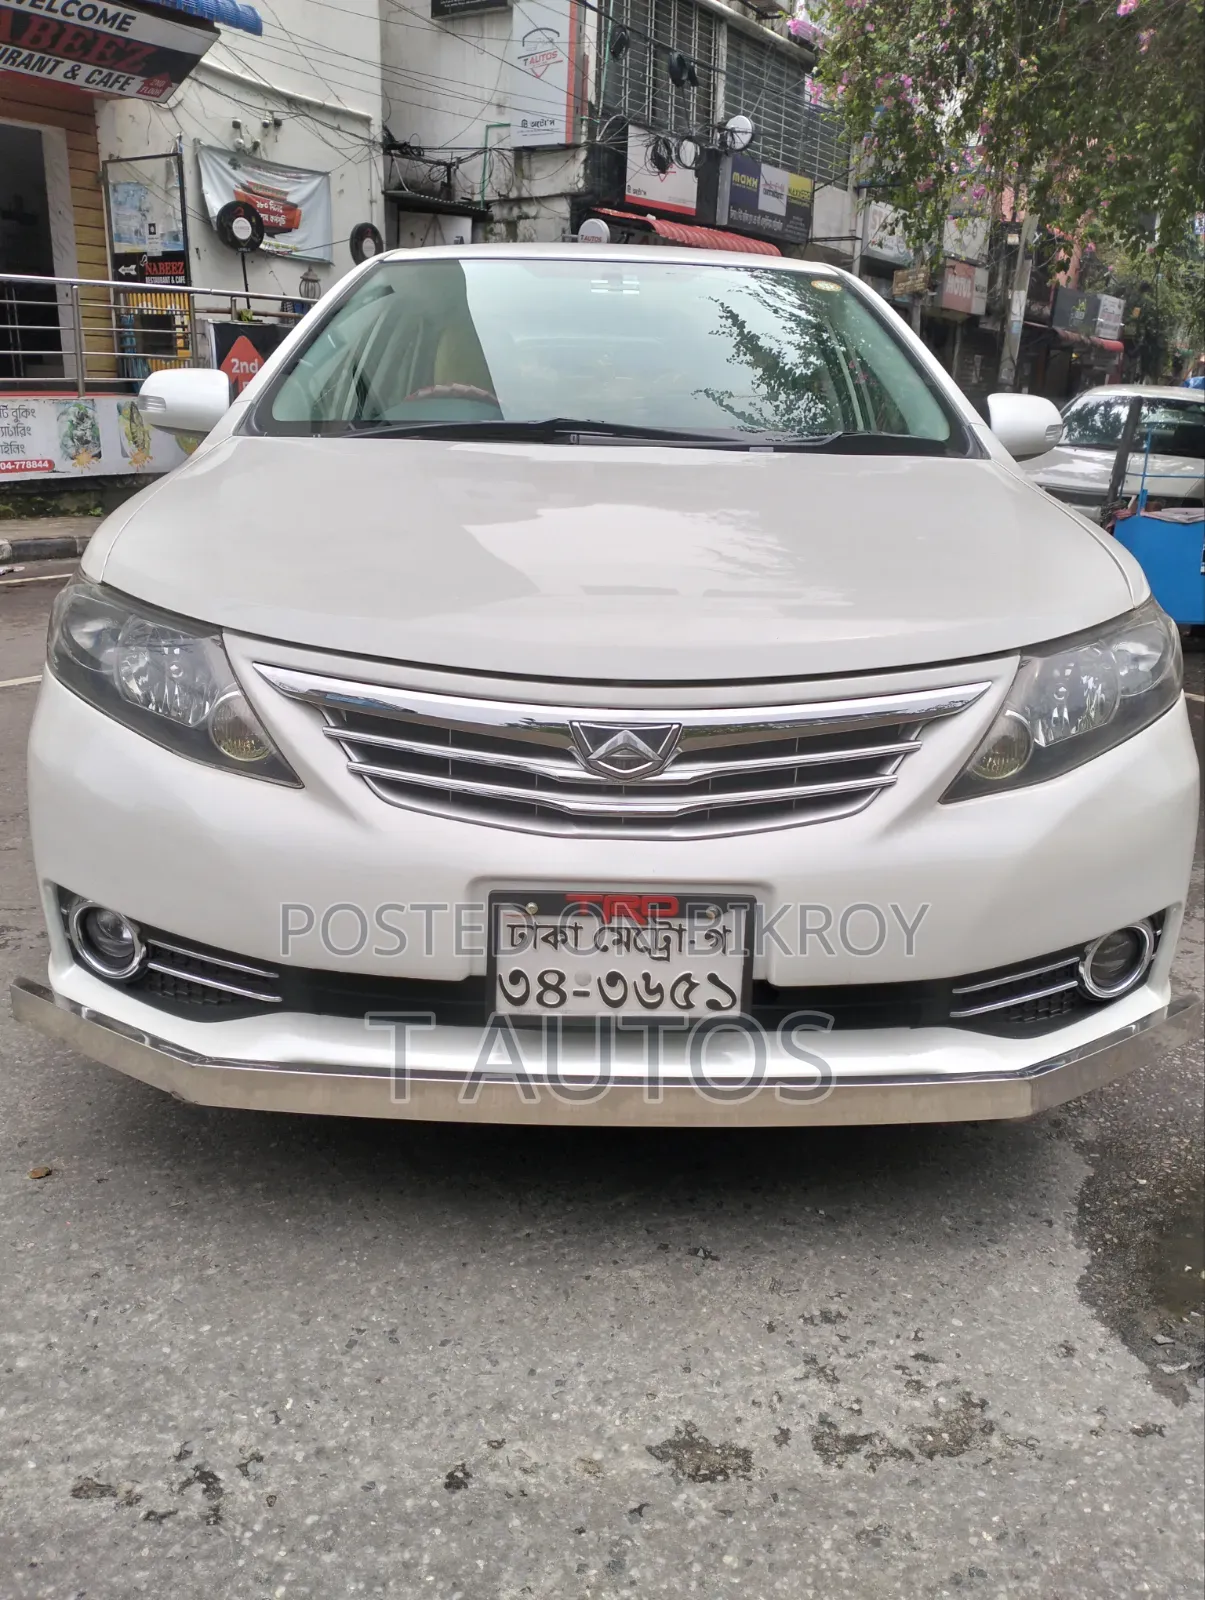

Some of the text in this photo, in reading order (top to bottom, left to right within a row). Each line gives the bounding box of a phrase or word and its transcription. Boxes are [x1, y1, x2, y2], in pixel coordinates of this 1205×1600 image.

[4, 0, 136, 32] ELCOME
[529, 50, 558, 65] AUTOS
[62, 64, 81, 81] &
[84, 72, 135, 92] CAFE
[144, 262, 185, 275] NABEEZ
[175, 276, 186, 284] CAFE
[231, 358, 259, 374] 2nd
[10, 404, 36, 423] বুকিং
[507, 921, 584, 951] ঢাকা
[498, 968, 737, 1010] ৩৪-৩৬৫১
